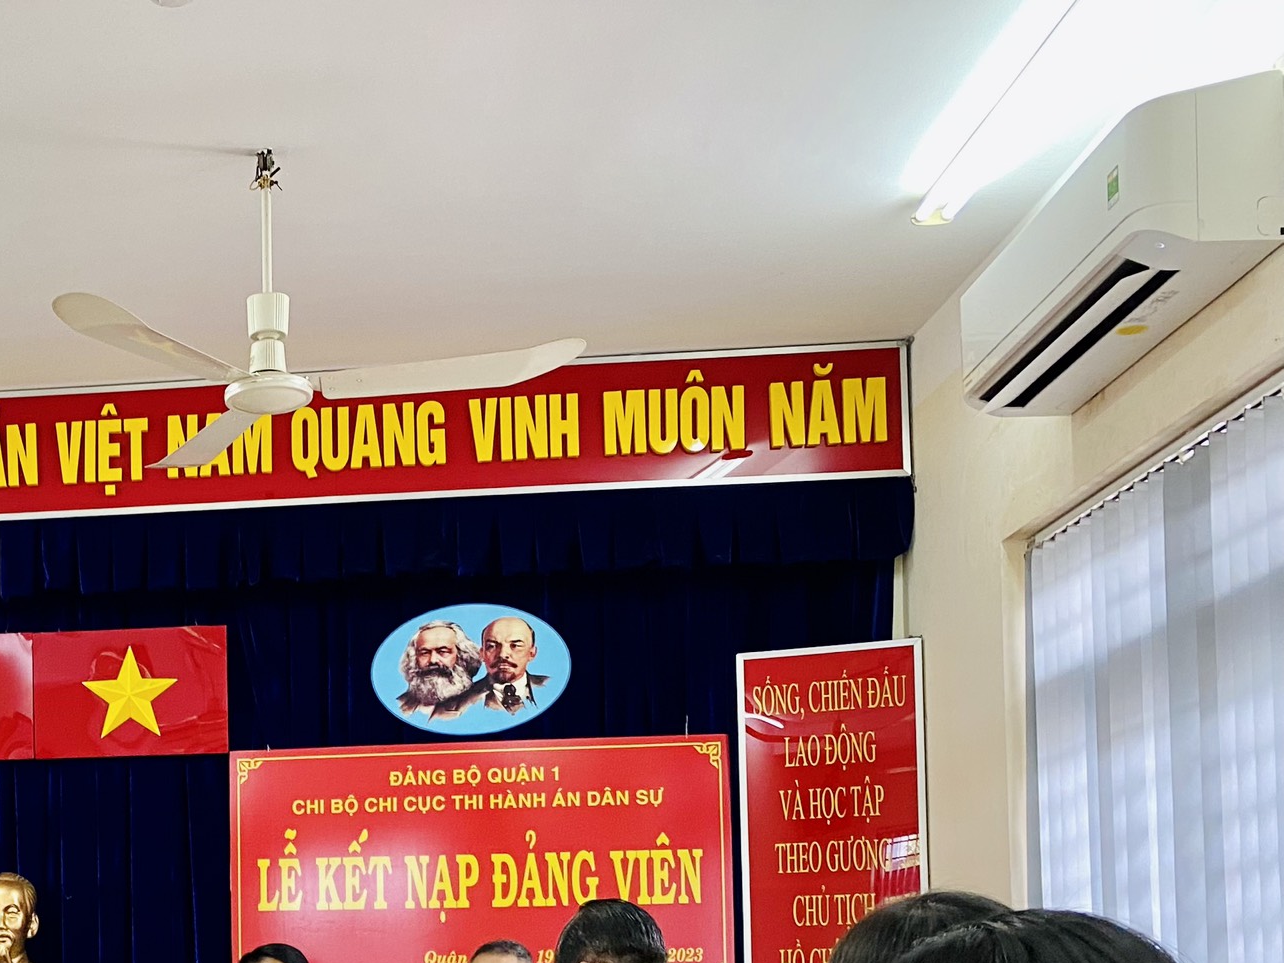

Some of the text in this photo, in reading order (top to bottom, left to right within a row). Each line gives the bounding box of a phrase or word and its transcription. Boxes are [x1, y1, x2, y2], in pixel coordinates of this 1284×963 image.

[55, 403, 149, 495] VIỆT
[291, 400, 446, 479] QUANG
[468, 393, 580, 462] VINH
[604, 369, 746, 457] MUÔN
[769, 362, 888, 449] NĂM
[752, 666, 906, 720] SỐNG, CHIẾN ĐẤU
[784, 723, 876, 771] LAO ĐỘNG
[389, 763, 560, 787] ĐẢNG BỘ QUẬN 1
[292, 786, 665, 816] CHI BỘ CHI CỤC THI HÀNH ÁN DÂN SỰ
[779, 775, 885, 826] VÀ HỌC TẬP
[256, 828, 704, 924] LỄ KẾT NẠP ĐẢNG VIÊN
[774, 841, 822, 874] THEO
[793, 884, 830, 927] CHỦ
[667, 947, 704, 963] 2023
